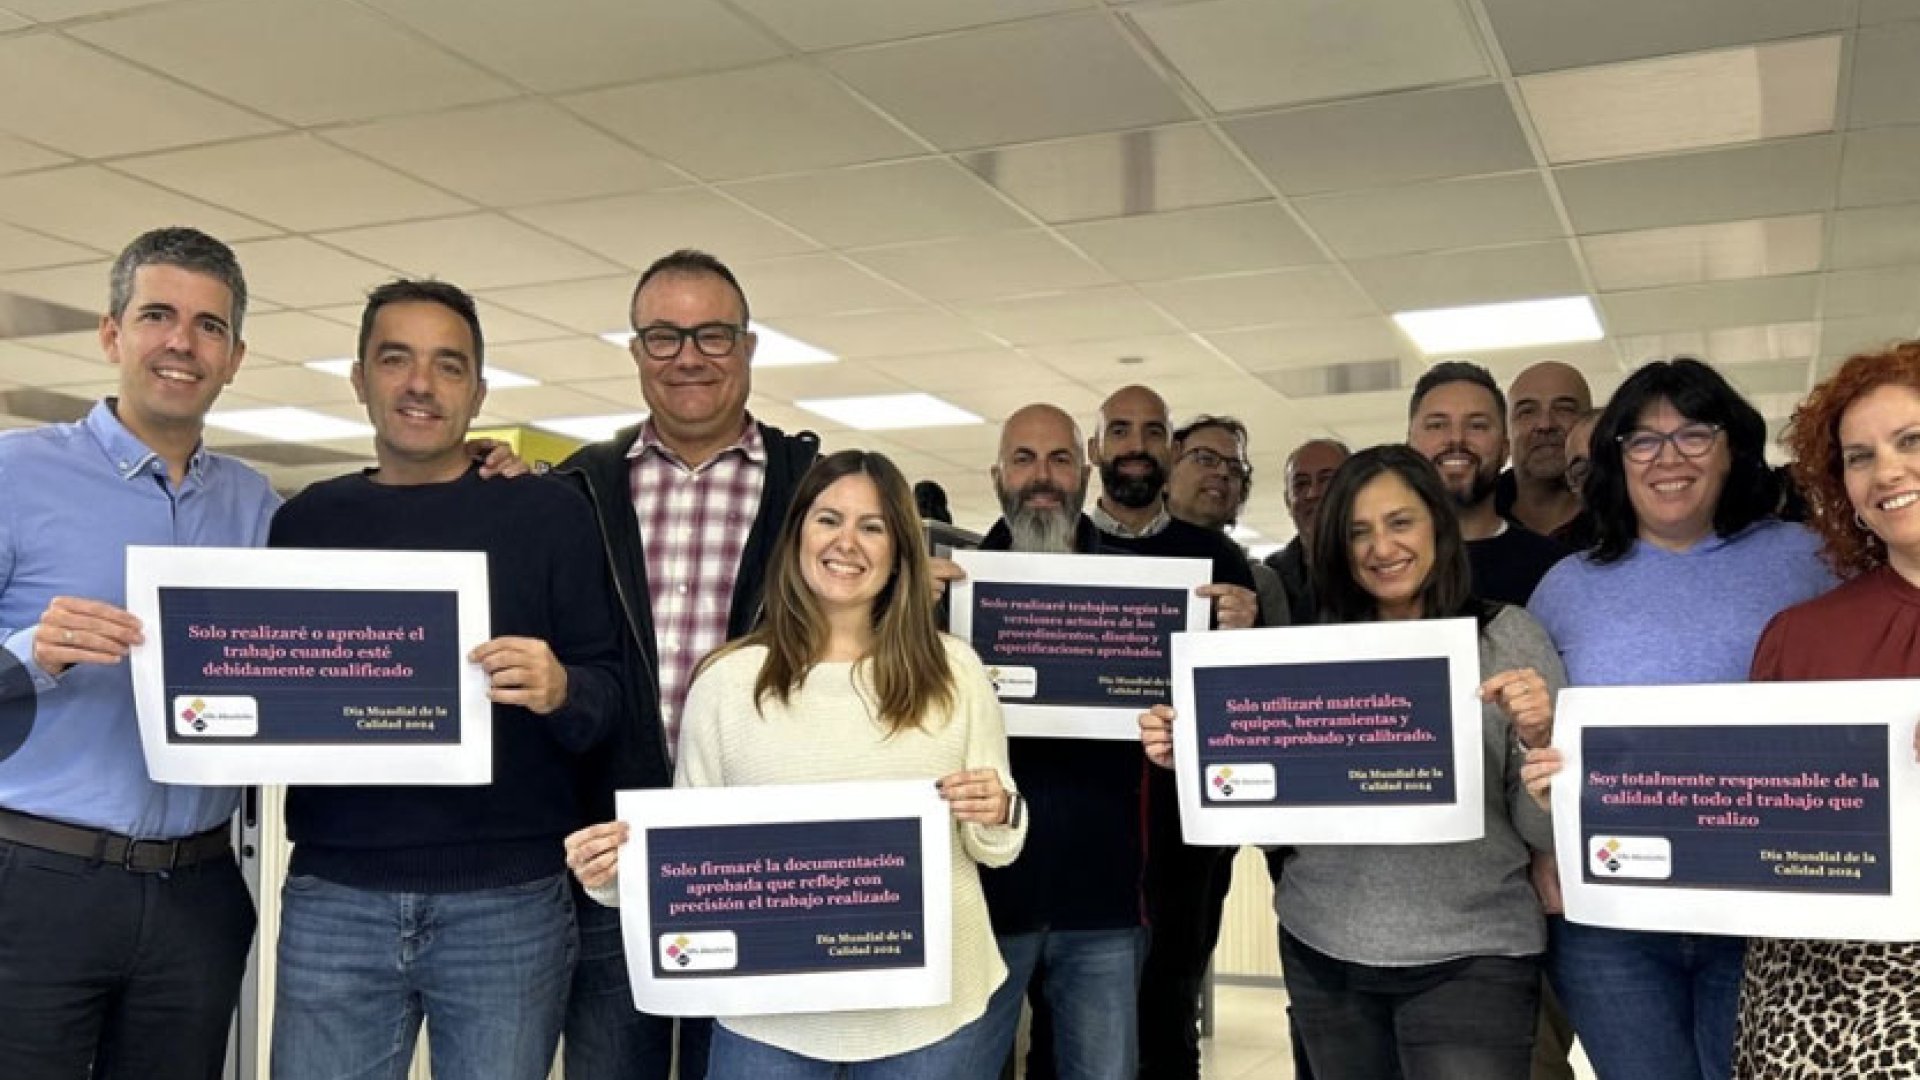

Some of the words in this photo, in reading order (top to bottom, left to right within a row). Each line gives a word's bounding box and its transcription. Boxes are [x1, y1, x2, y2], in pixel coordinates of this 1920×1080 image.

[980, 598, 1007, 608] Solo
[1011, 598, 1065, 611] realizaré
[1069, 600, 1118, 614] trabajos
[1122, 601, 1158, 615] según
[1161, 601, 1179, 615] las
[1004, 614, 1062, 626] versiones
[1065, 616, 1116, 627] actuales
[1118, 616, 1133, 627] de
[1136, 616, 1155, 628] los
[189, 625, 226, 639] Solo
[230, 626, 307, 639] realizaré
[311, 630, 323, 639] o
[326, 626, 404, 643] aprobaré
[409, 627, 424, 640] el
[998, 628, 1098, 641] procedimientos,
[1101, 631, 1149, 643] diseños
[1151, 636, 1157, 644] y
[223, 645, 286, 660] trabajo
[290, 646, 353, 659] cuando
[357, 645, 392, 659] esté
[993, 642, 1093, 656] especificaciones
[1097, 646, 1162, 657] aprobados
[203, 663, 315, 677] debidamente
[320, 664, 413, 677] cualificado
[1226, 699, 1259, 713] Solo
[1262, 696, 1323, 712] utilizaré
[1327, 693, 1412, 710] materiales,
[367, 707, 417, 716] Mundial
[419, 707, 433, 717] de
[436, 707, 447, 717] la
[357, 720, 401, 729] Calidad
[406, 721, 434, 731] 2024
[1231, 716, 1292, 730] equipos,
[1295, 713, 1397, 728] herramientas
[1400, 714, 1409, 727] y
[1208, 733, 1271, 746] software
[1274, 731, 1345, 748] aprobado
[1347, 733, 1354, 746] y
[1359, 729, 1436, 742] calibrado.
[1369, 769, 1414, 779] Mundial
[1417, 768, 1430, 778] de
[1433, 768, 1443, 777] la
[1589, 771, 1619, 788] Soy
[1622, 771, 1715, 786] totalmente
[1719, 773, 1830, 790] responsable
[1834, 773, 1858, 788] de
[1862, 773, 1879, 789] la
[1361, 782, 1401, 791] Calidad
[1601, 790, 1662, 805] calidad
[1666, 792, 1687, 806] de
[1692, 792, 1731, 806] todo
[1736, 792, 1753, 807] el
[1756, 793, 1823, 810] trabajo
[1828, 796, 1863, 811] que
[1697, 812, 1759, 827] realizo
[1786, 850, 1840, 862] Mundial
[1844, 852, 1860, 863] de
[1863, 852, 1876, 863] la
[661, 864, 697, 877] Solo
[700, 860, 763, 875] firmaré
[766, 859, 780, 872] la
[783, 853, 904, 871] documentación
[1774, 864, 1824, 876] Calidad
[1828, 867, 1861, 879] 2024
[687, 878, 762, 896] aprobada
[766, 879, 796, 893] que
[799, 875, 849, 890] refleje
[853, 874, 881, 886] con
[670, 897, 744, 915] precisión
[748, 896, 762, 909] el
[766, 893, 823, 909] trabajo
[827, 891, 900, 905] realizado
[838, 932, 884, 943] Mundial
[887, 931, 899, 941] de
[902, 931, 913, 940] la
[828, 945, 869, 956] Calidad
